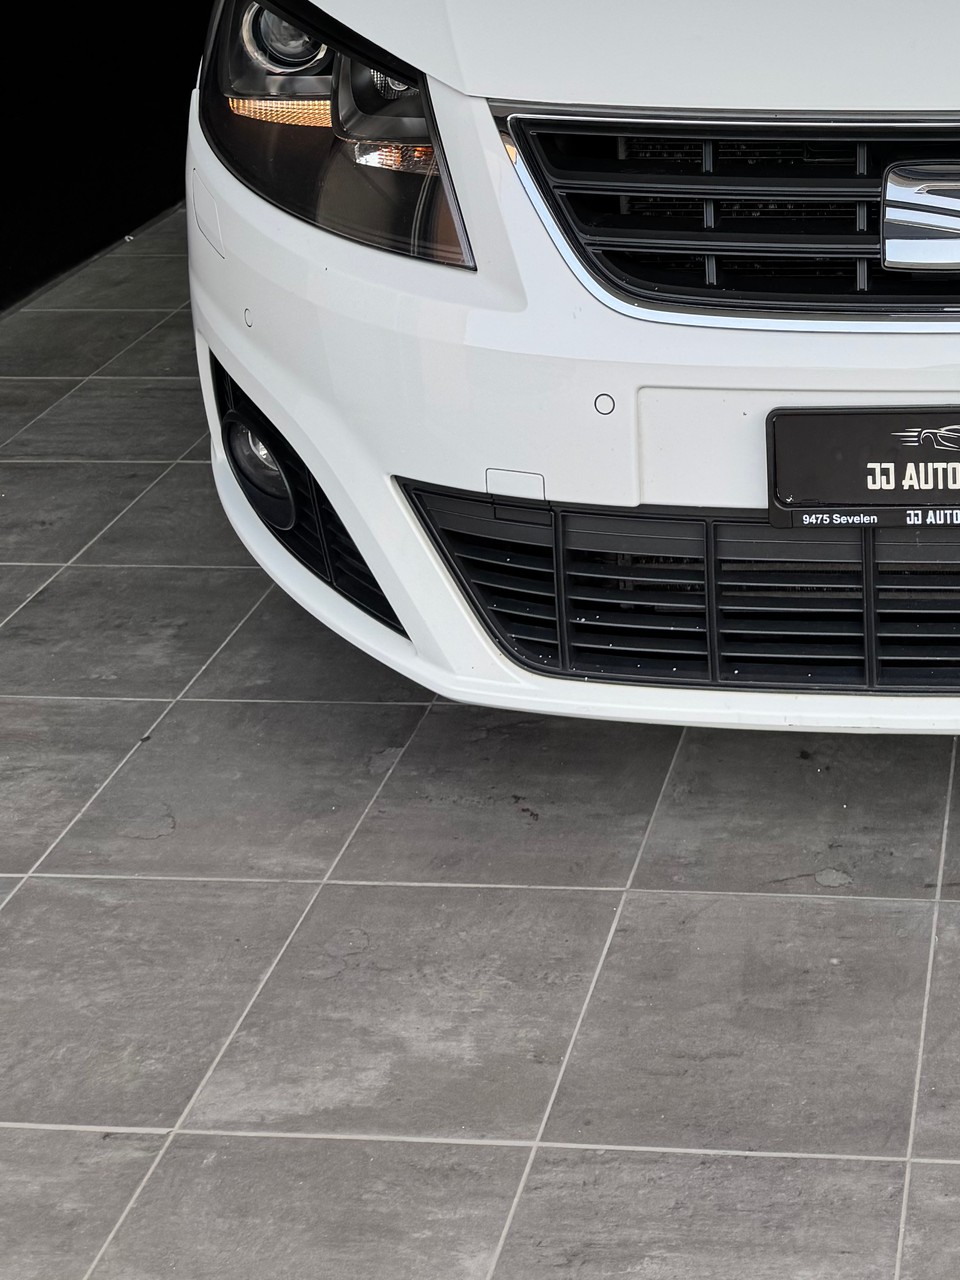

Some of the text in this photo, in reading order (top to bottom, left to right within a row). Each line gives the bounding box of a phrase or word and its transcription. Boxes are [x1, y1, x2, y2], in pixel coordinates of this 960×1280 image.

[866, 462, 896, 490] JJ
[802, 513, 878, 524] 9475 Sevelen
[906, 511, 922, 525] JJ
